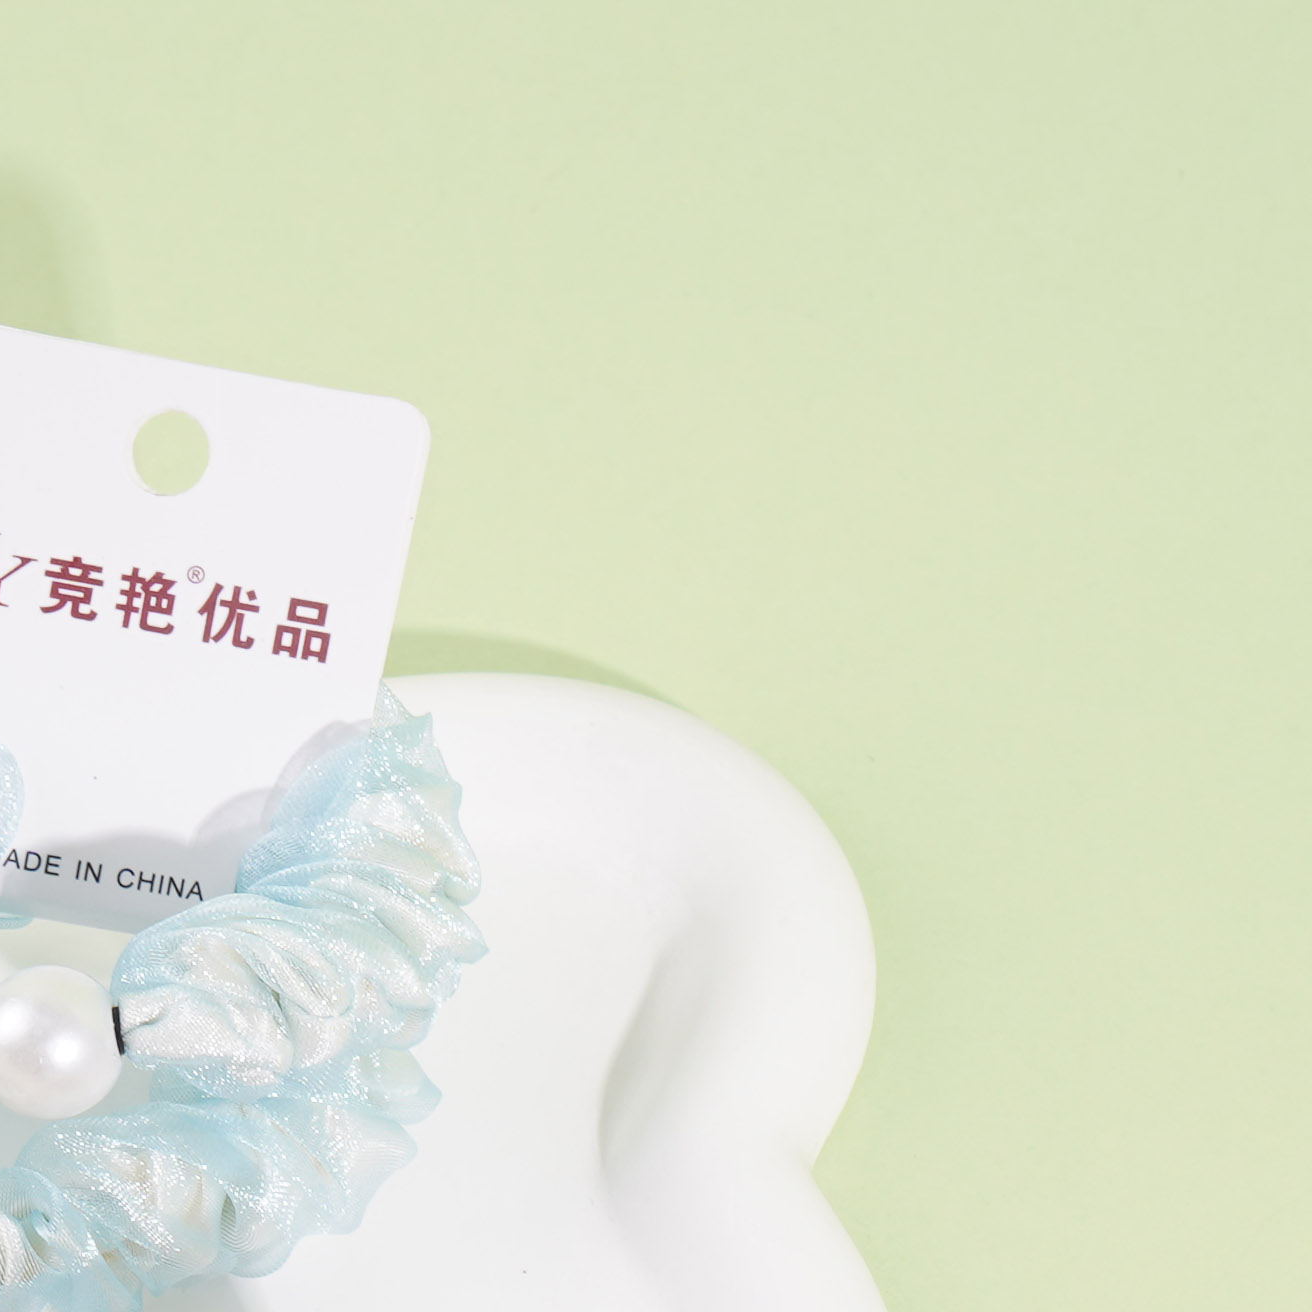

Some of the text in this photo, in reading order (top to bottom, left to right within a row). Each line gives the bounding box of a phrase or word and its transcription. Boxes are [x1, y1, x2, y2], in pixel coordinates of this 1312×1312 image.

[40, 555, 331, 663] 竞艳优品
[75, 859, 103, 884] IN
[116, 867, 205, 902] CHINA
